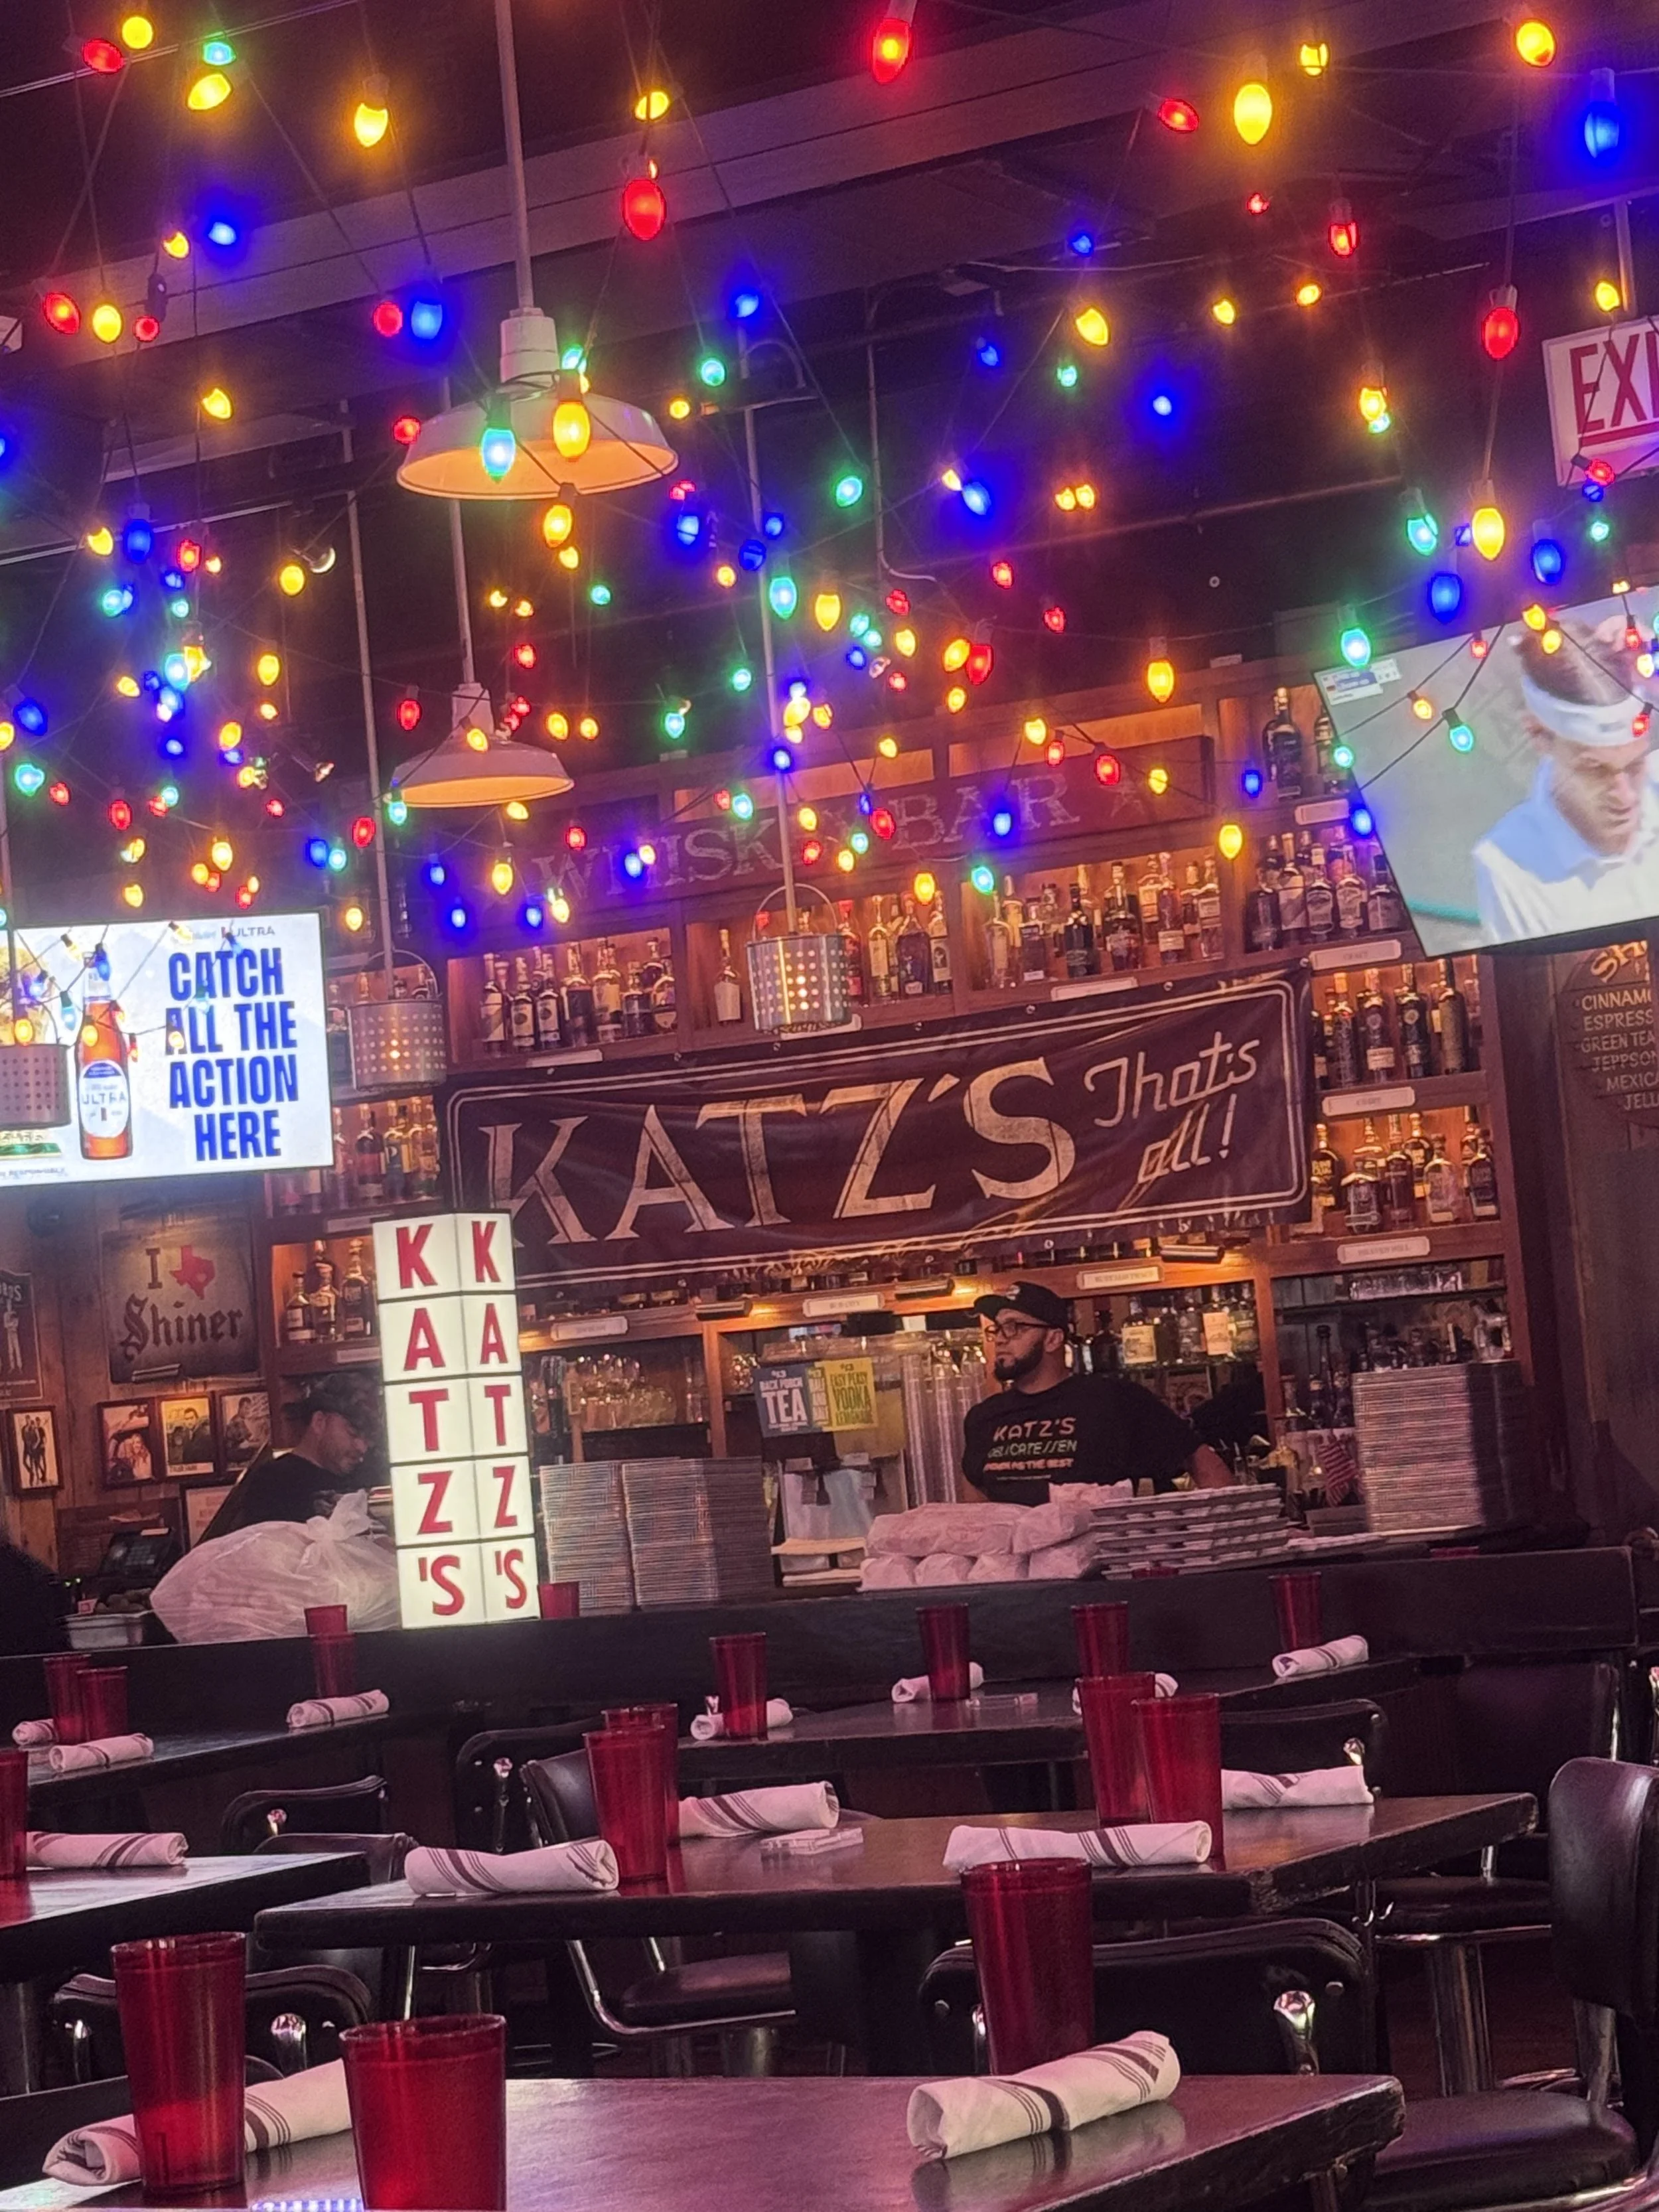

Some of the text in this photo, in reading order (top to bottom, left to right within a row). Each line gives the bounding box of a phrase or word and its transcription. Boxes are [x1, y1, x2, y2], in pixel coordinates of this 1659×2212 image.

[888, 773, 1080, 850] BAR
[169, 947, 284, 1001] CATCH
[166, 1001, 298, 1055] ALL THE
[1581, 1030, 1656, 1053] GREEN TEA
[170, 1055, 299, 1109] ACTION
[194, 1110, 281, 1161] HERE
[478, 1057, 1076, 1248] KATZ'S
[1138, 1094, 1237, 1183] all!
[145, 1247, 163, 1290] I
[119, 1293, 243, 1361] Shiner
[396, 1223, 465, 1616] KATZ'S
[471, 1220, 528, 1610] KATZ'S
[761, 1388, 808, 1426] TEA
[832, 1385, 871, 1411] VODKA
[993, 1417, 1076, 1441] KATZ'S
